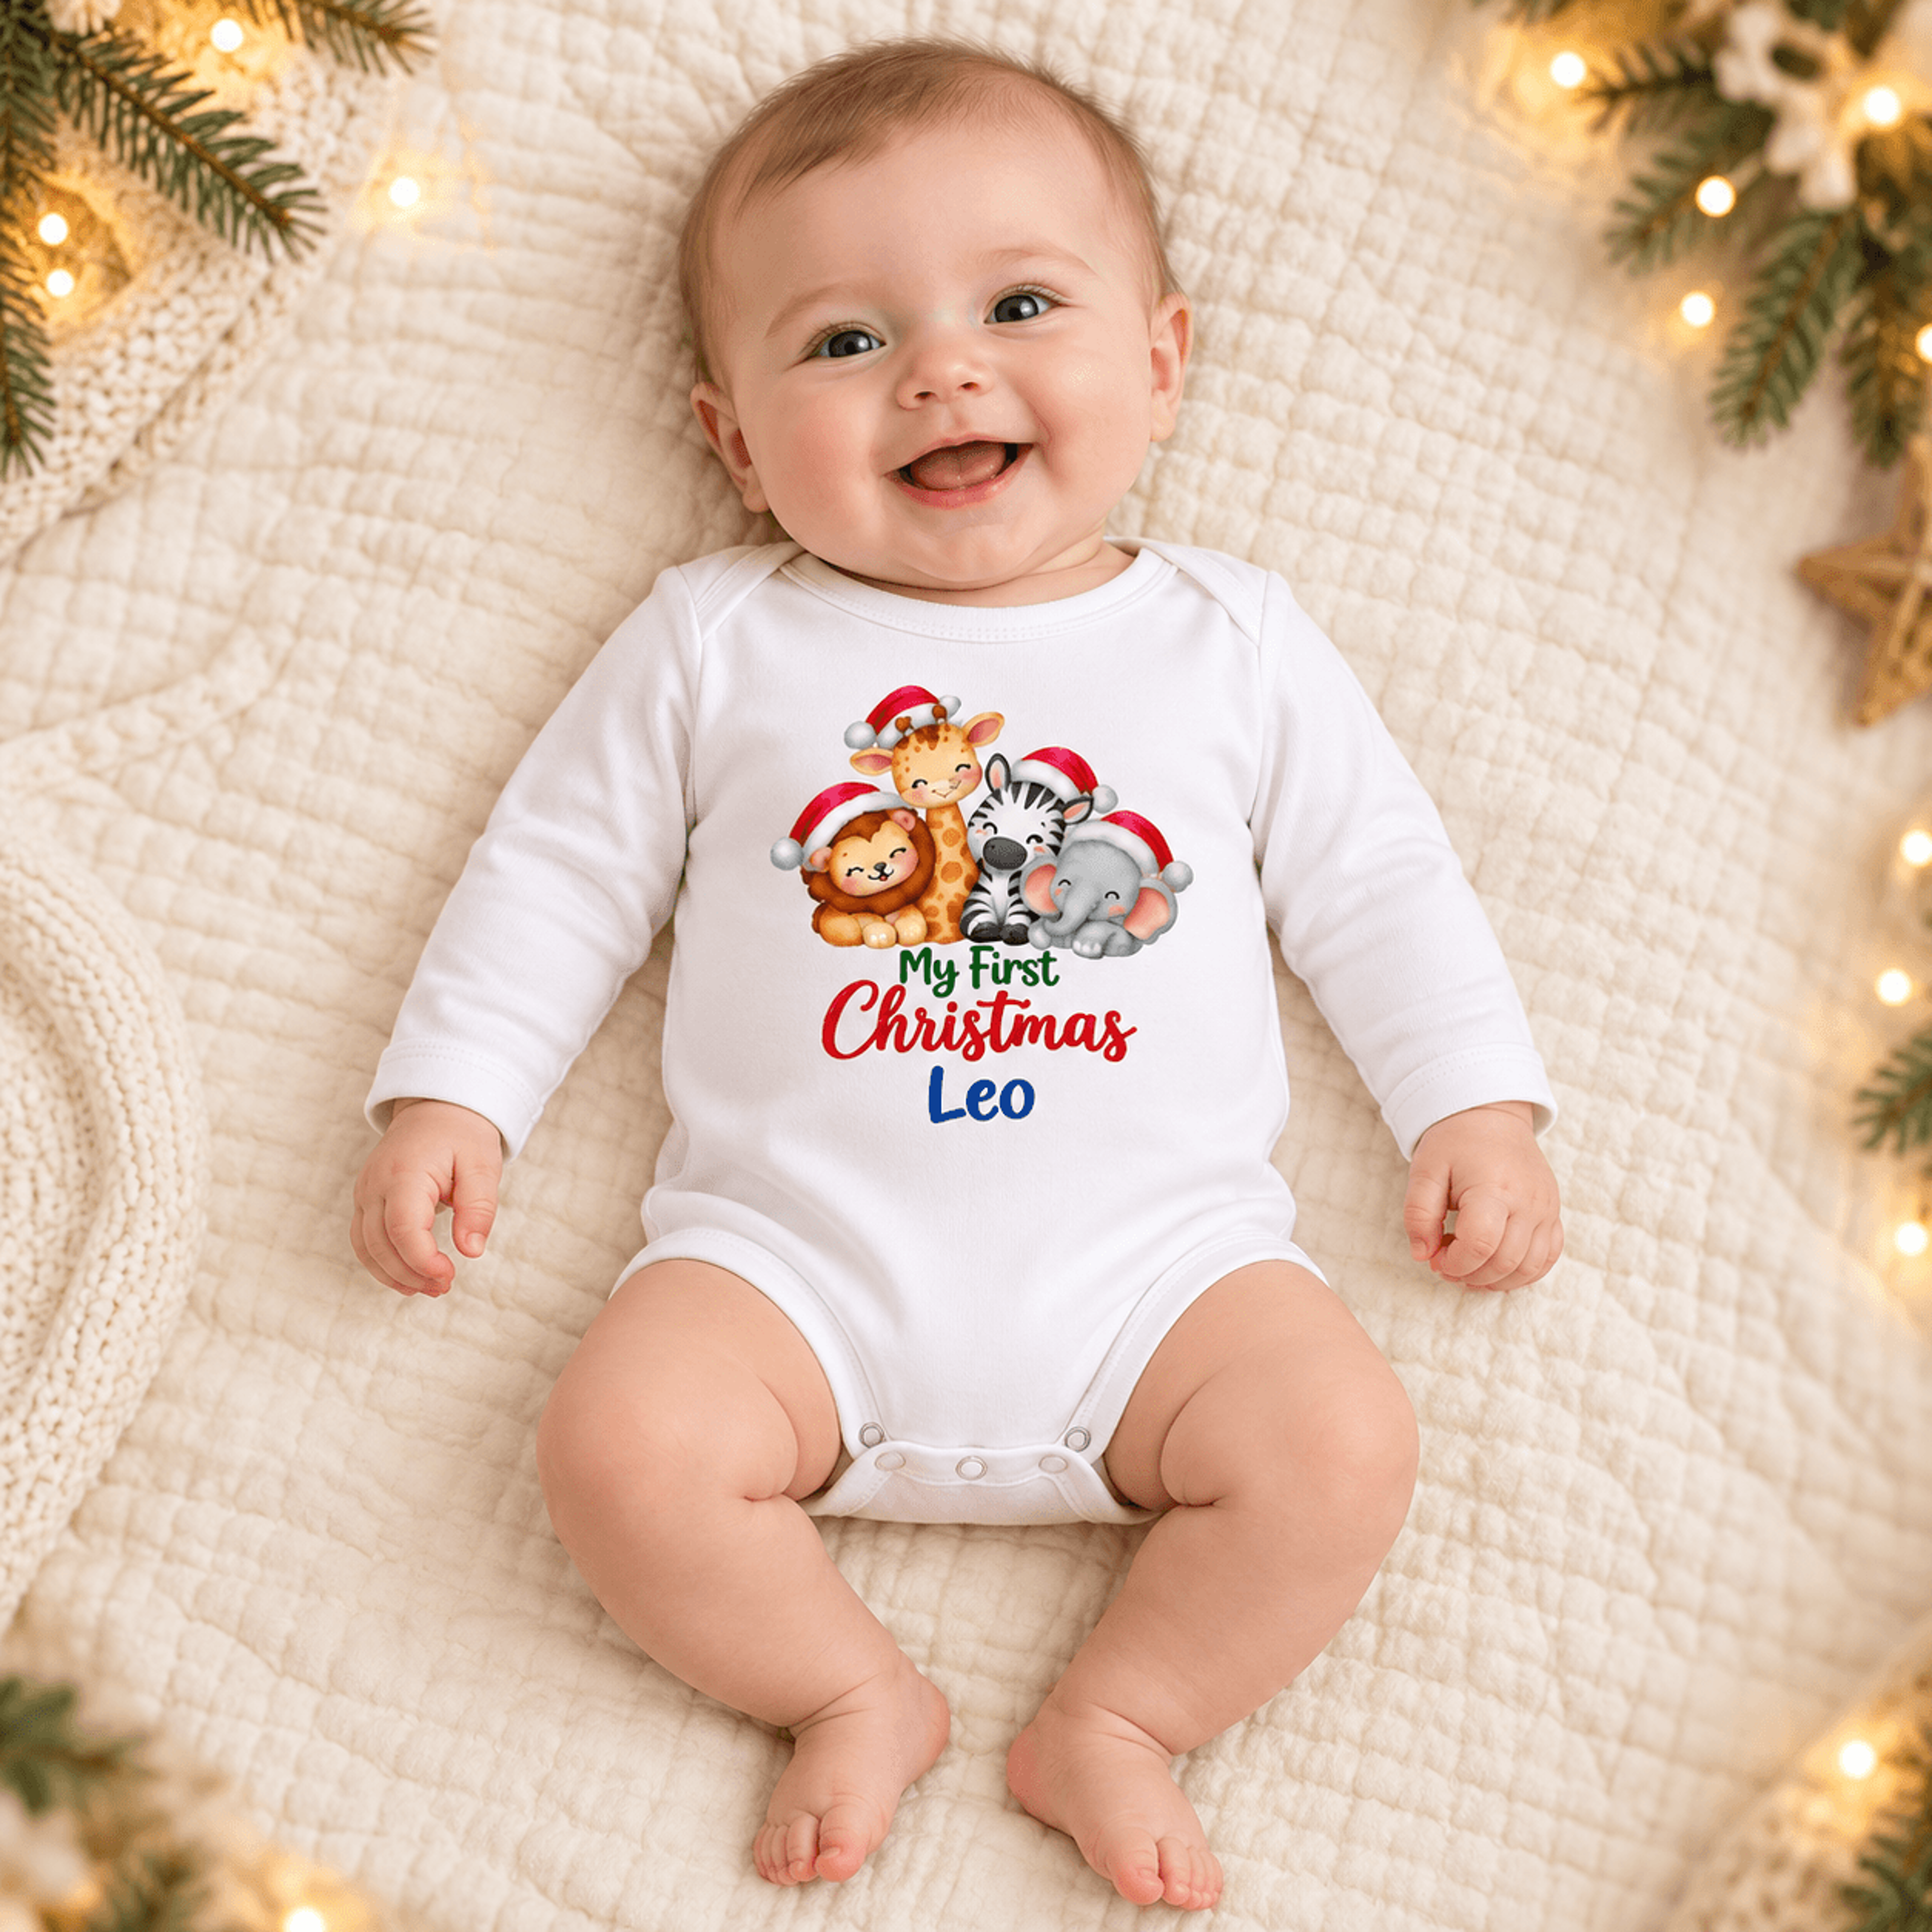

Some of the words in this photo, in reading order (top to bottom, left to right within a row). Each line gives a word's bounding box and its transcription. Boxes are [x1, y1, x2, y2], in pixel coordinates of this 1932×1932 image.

[899, 947, 959, 998] My
[969, 945, 1060, 989] First
[821, 980, 1138, 1063] Christmas
[928, 1065, 1035, 1123] Leo
